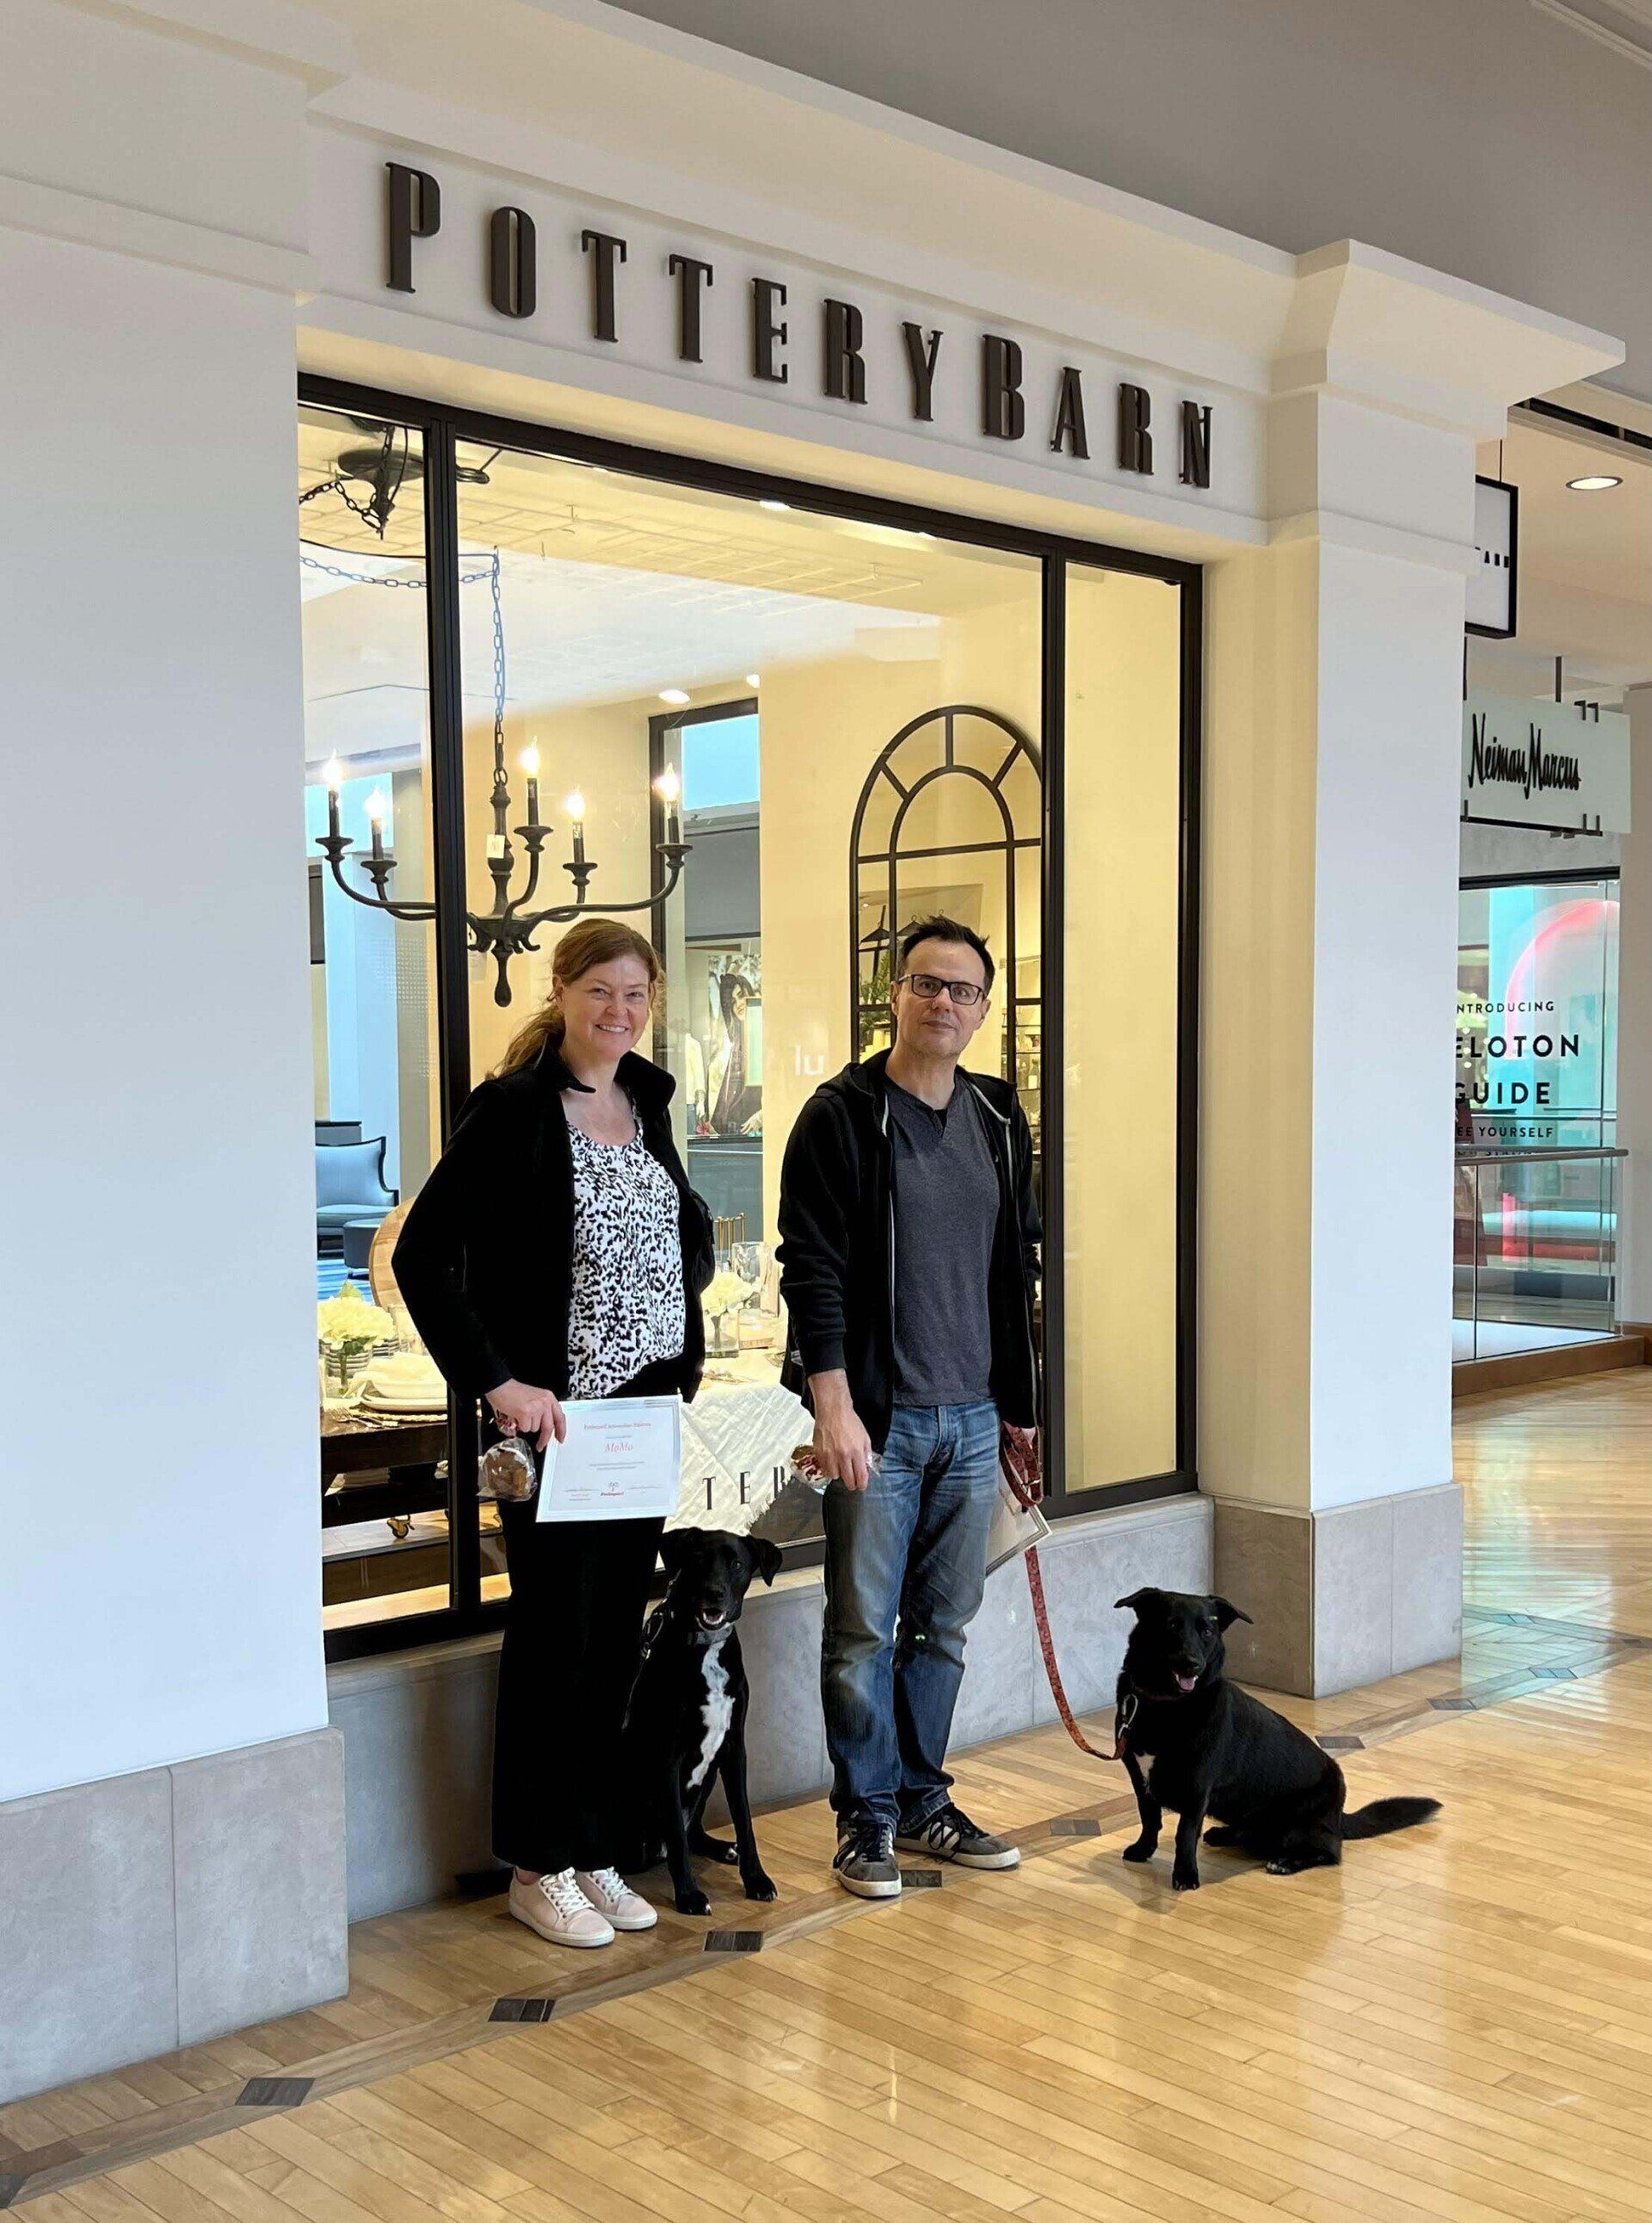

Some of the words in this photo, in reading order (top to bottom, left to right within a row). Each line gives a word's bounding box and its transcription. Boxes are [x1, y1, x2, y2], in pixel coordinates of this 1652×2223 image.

[385, 162, 943, 421] POTTERY
[983, 334, 1212, 488] BARN
[1468, 713, 1527, 788] Neiman
[1524, 723, 1581, 800] Marcus
[1457, 1001, 1554, 1013] NTRODUCING
[1456, 1034, 1579, 1058] ELOTON
[1457, 1127, 1473, 1137] EE
[1479, 1127, 1554, 1138] YOURSELF
